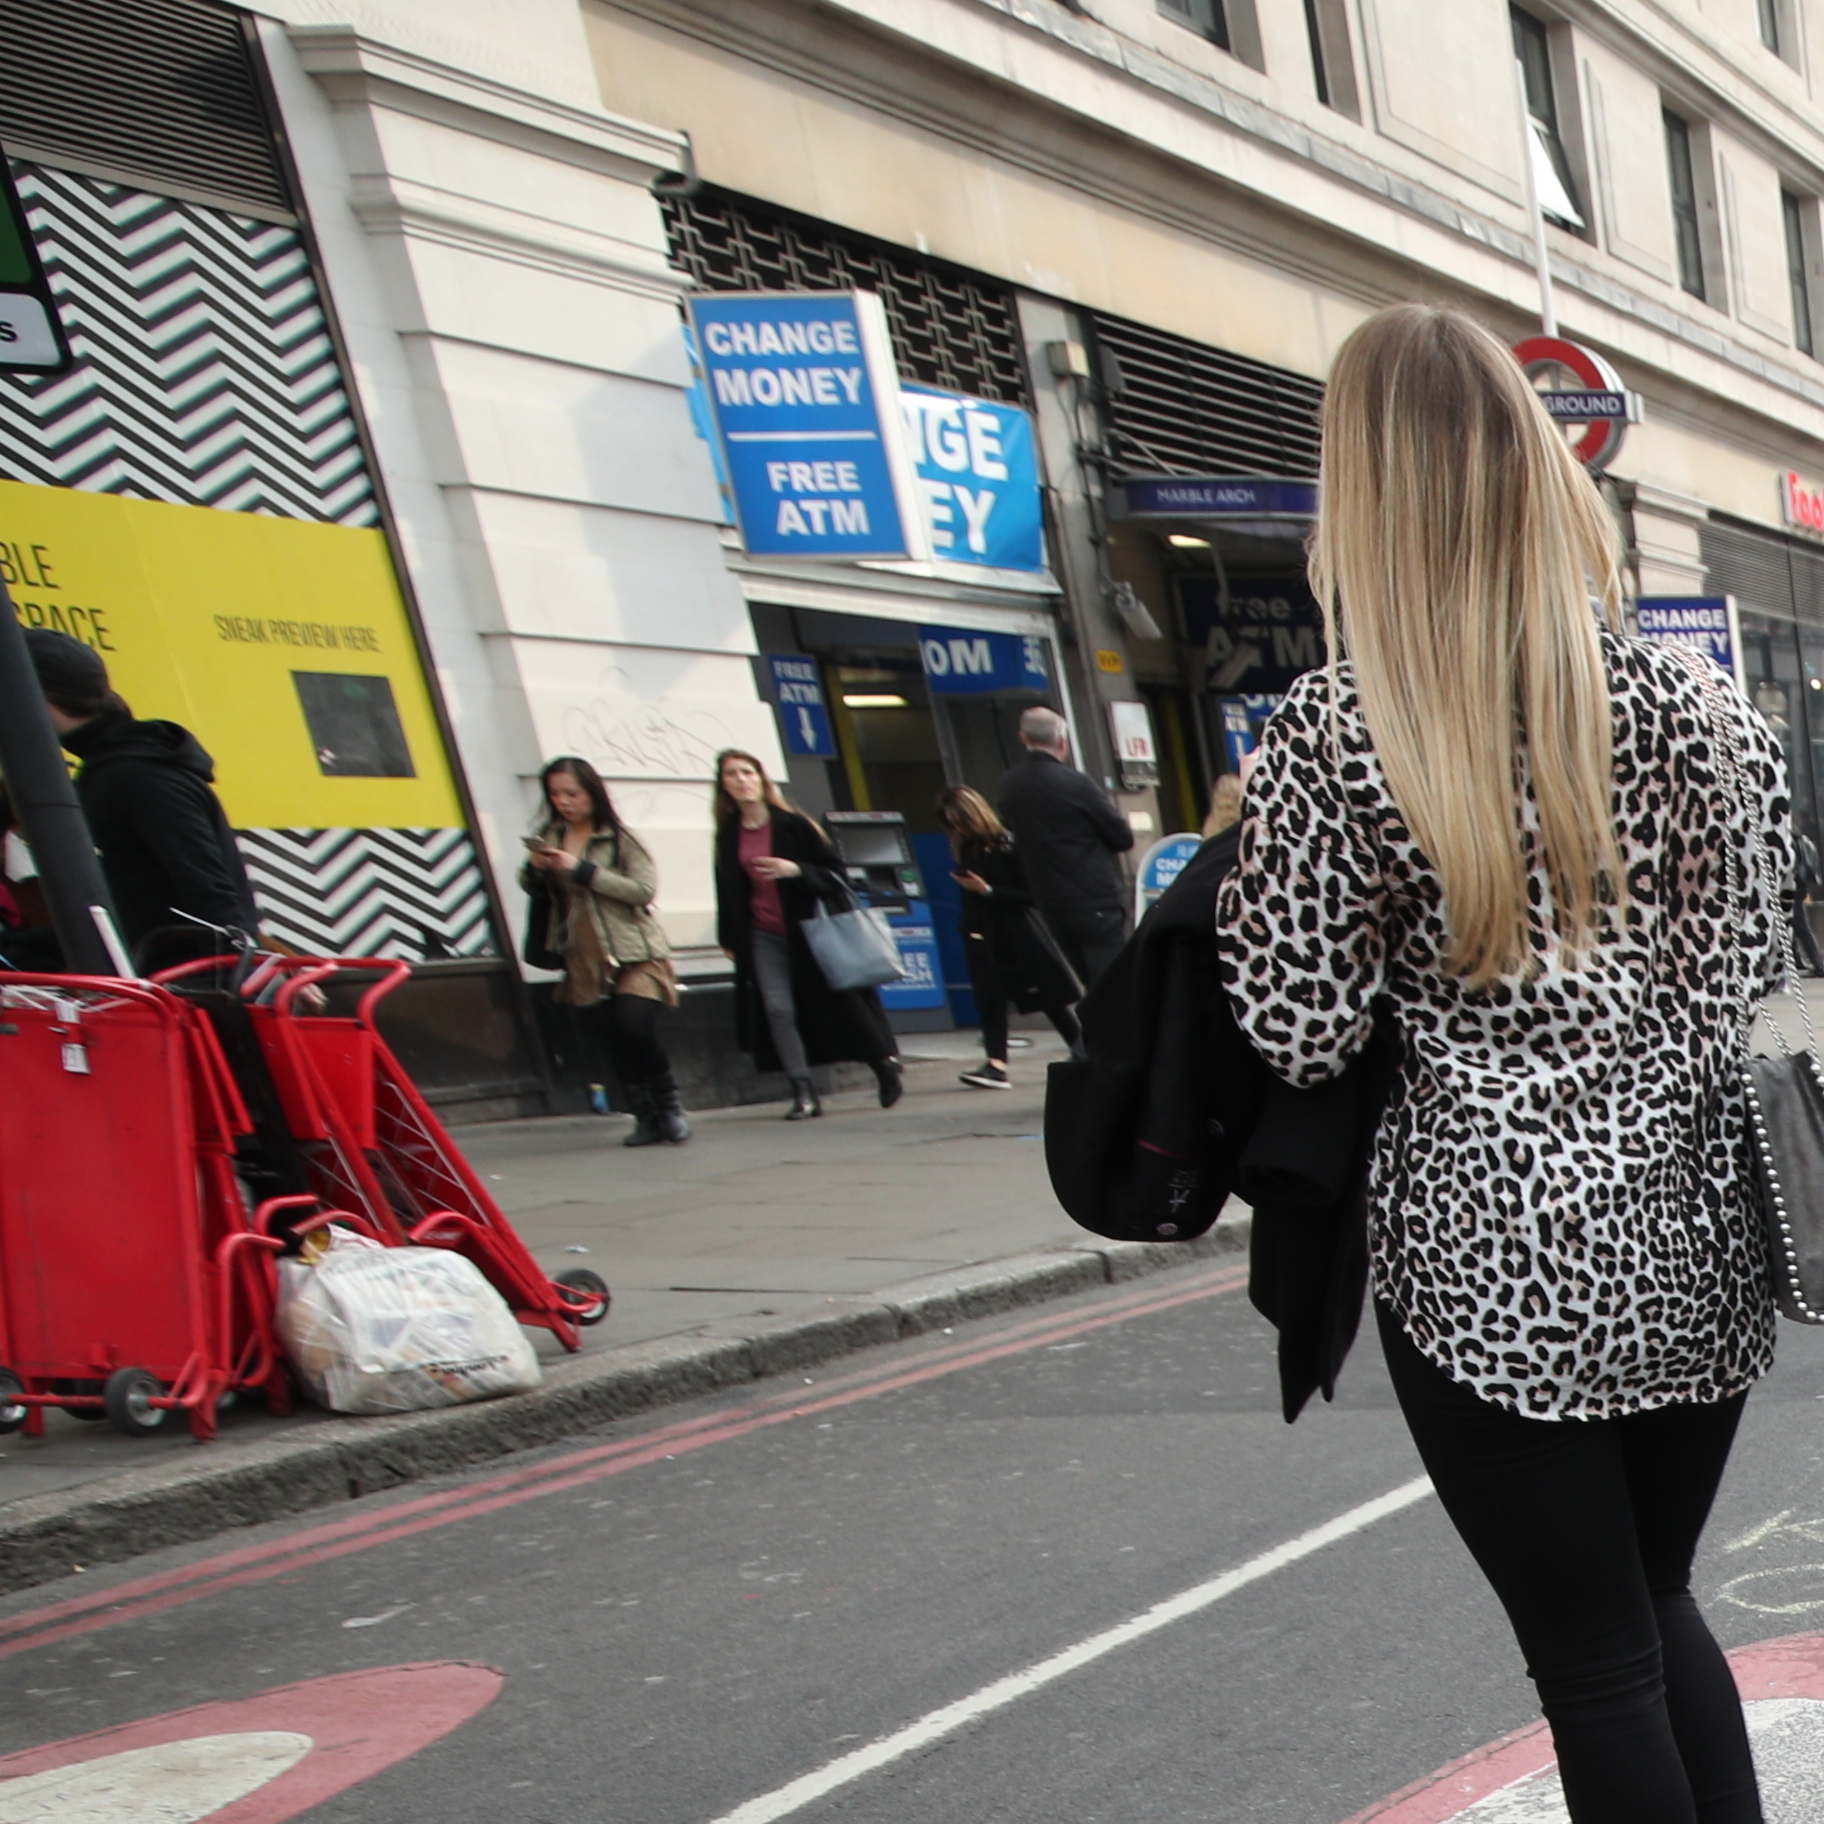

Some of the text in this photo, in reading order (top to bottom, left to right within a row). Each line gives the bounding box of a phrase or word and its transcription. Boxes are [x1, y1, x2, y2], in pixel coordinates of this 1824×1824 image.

[705, 321, 860, 357] CHANGE
[713, 367, 862, 406] MONEY
[766, 461, 862, 492] FREE
[1157, 488, 1256, 503] MARBLE ARCH
[776, 499, 871, 537] ATM
[213, 614, 382, 653] SNEAK PREVIEW HERE
[1637, 608, 1728, 630] CHANGE
[773, 660, 816, 681] FREE
[779, 682, 822, 704] ATM
